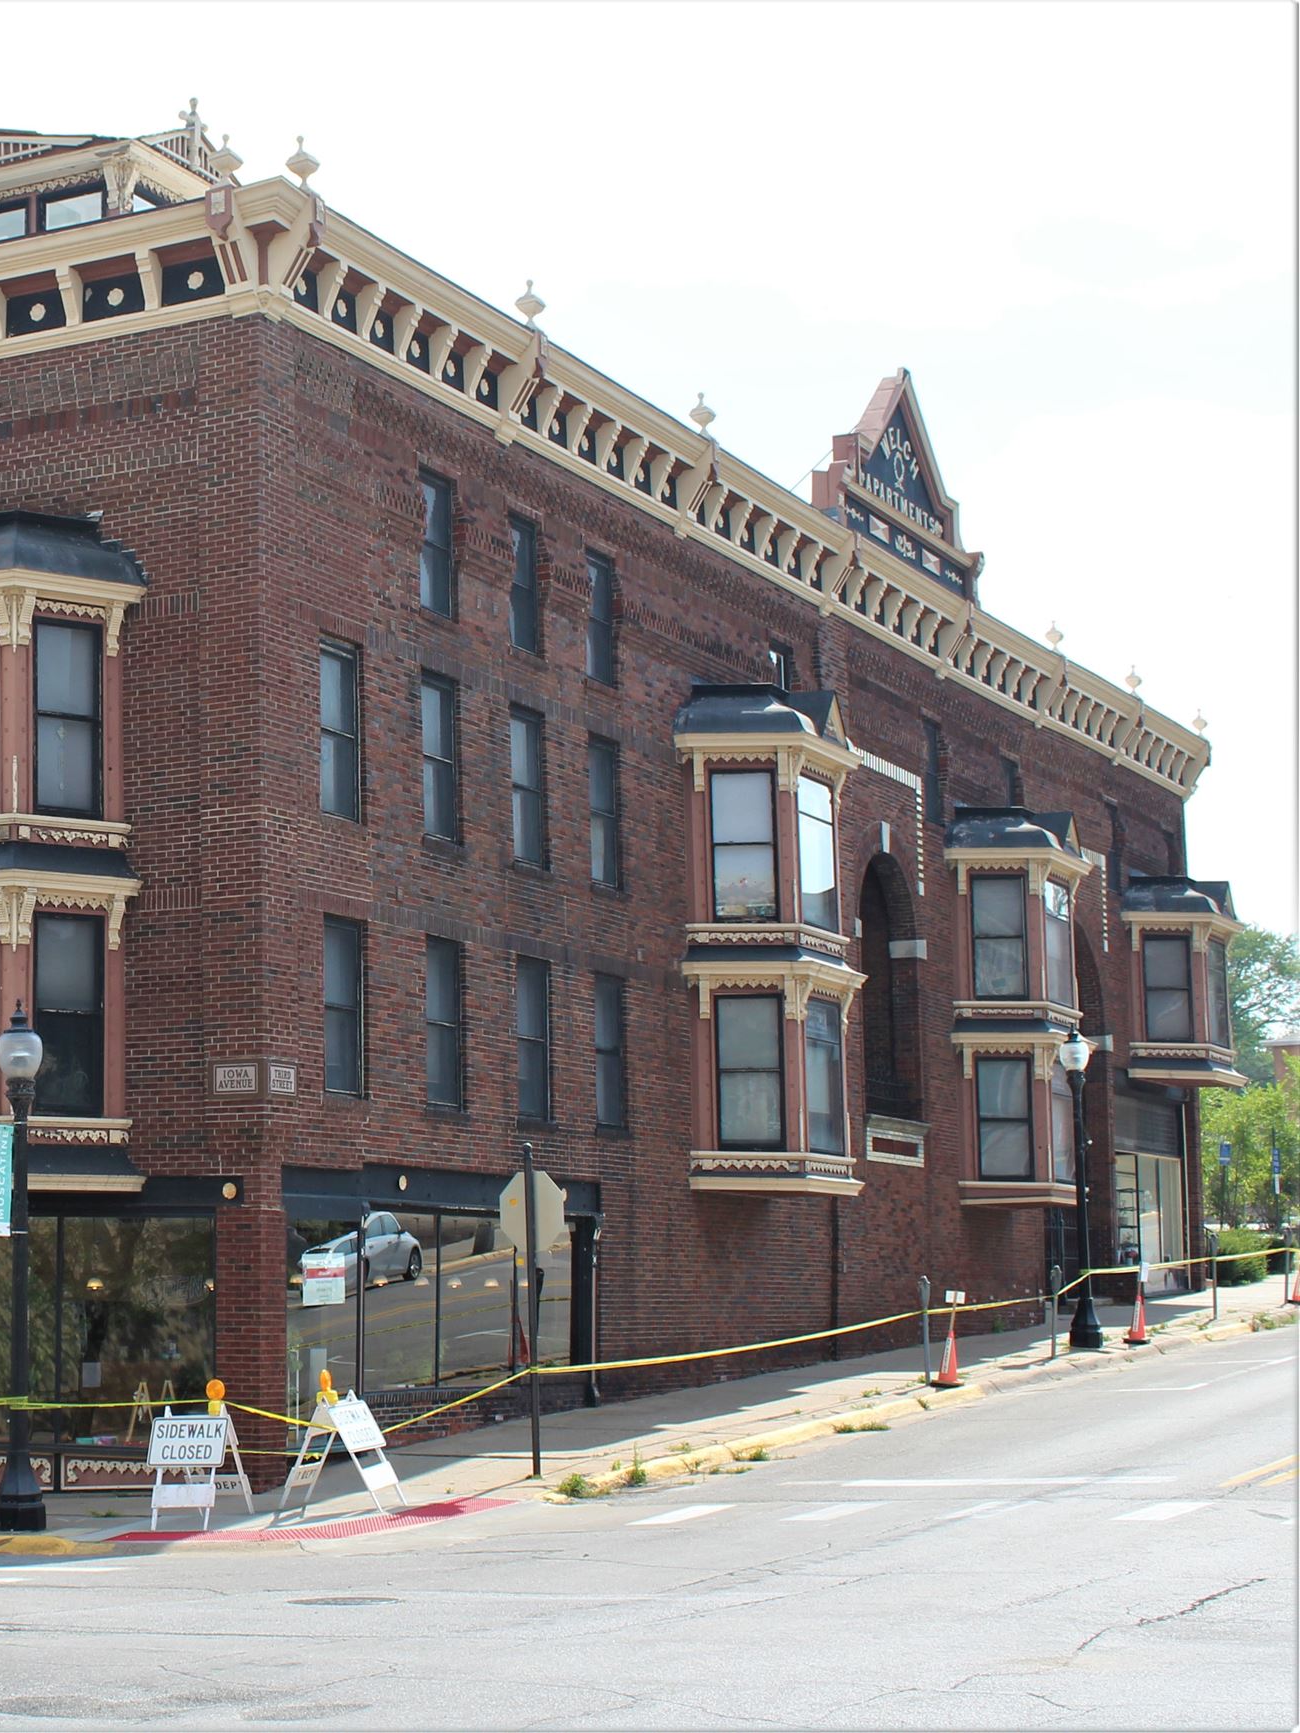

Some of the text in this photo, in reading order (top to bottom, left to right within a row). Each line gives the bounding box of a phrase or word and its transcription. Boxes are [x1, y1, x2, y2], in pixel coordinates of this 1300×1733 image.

[880, 427, 920, 480] WELCH
[866, 474, 935, 534] APARTMENTS
[223, 1069, 249, 1079] IOWA
[274, 1069, 292, 1080] THIRD
[218, 1079, 253, 1089] AVENUE
[271, 1079, 293, 1090] STREET
[156, 1423, 224, 1439] SIDEWALK
[161, 1444, 213, 1460] CLOSED
[216, 1481, 242, 1490] DEP
